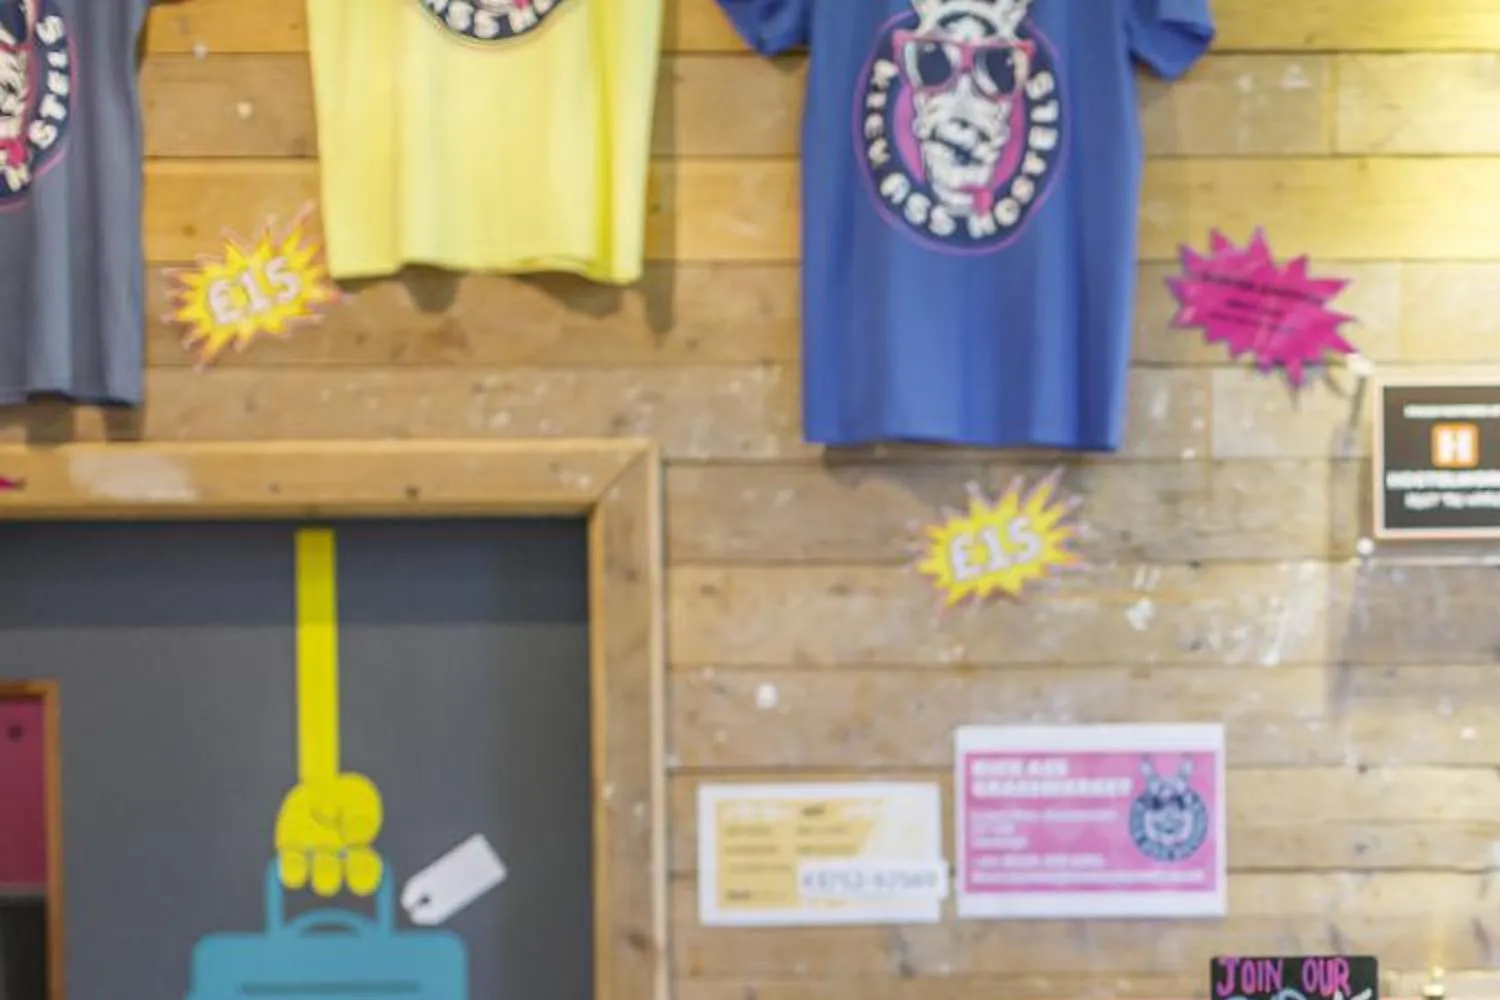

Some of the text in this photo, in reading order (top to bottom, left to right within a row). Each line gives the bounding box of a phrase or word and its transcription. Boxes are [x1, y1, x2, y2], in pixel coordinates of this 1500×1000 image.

[5, 15, 70, 192] HSTELS
[865, 59, 1059, 239] KICK ASS HOSTELS
[208, 256, 302, 325] £15
[951, 516, 1040, 581] £15
[1216, 957, 1351, 997] JOIN OUR
